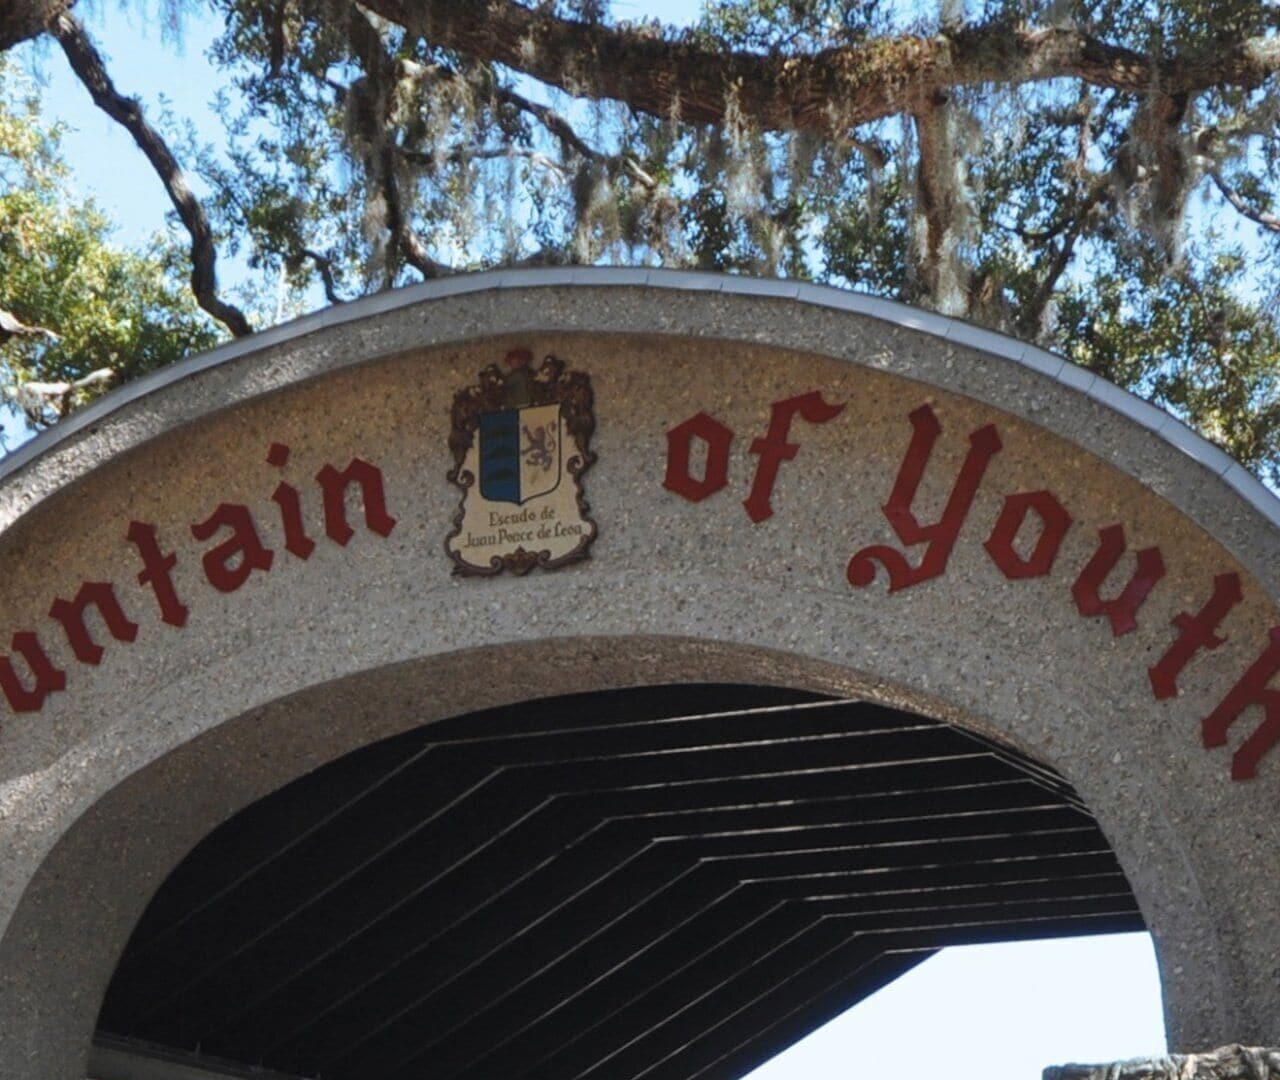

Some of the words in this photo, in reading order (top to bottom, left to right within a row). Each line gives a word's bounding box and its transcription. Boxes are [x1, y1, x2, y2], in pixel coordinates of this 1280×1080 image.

[663, 390, 847, 524] of
[489, 508, 537, 527] Escudo
[540, 505, 556, 520] de
[537, 523, 552, 540] de
